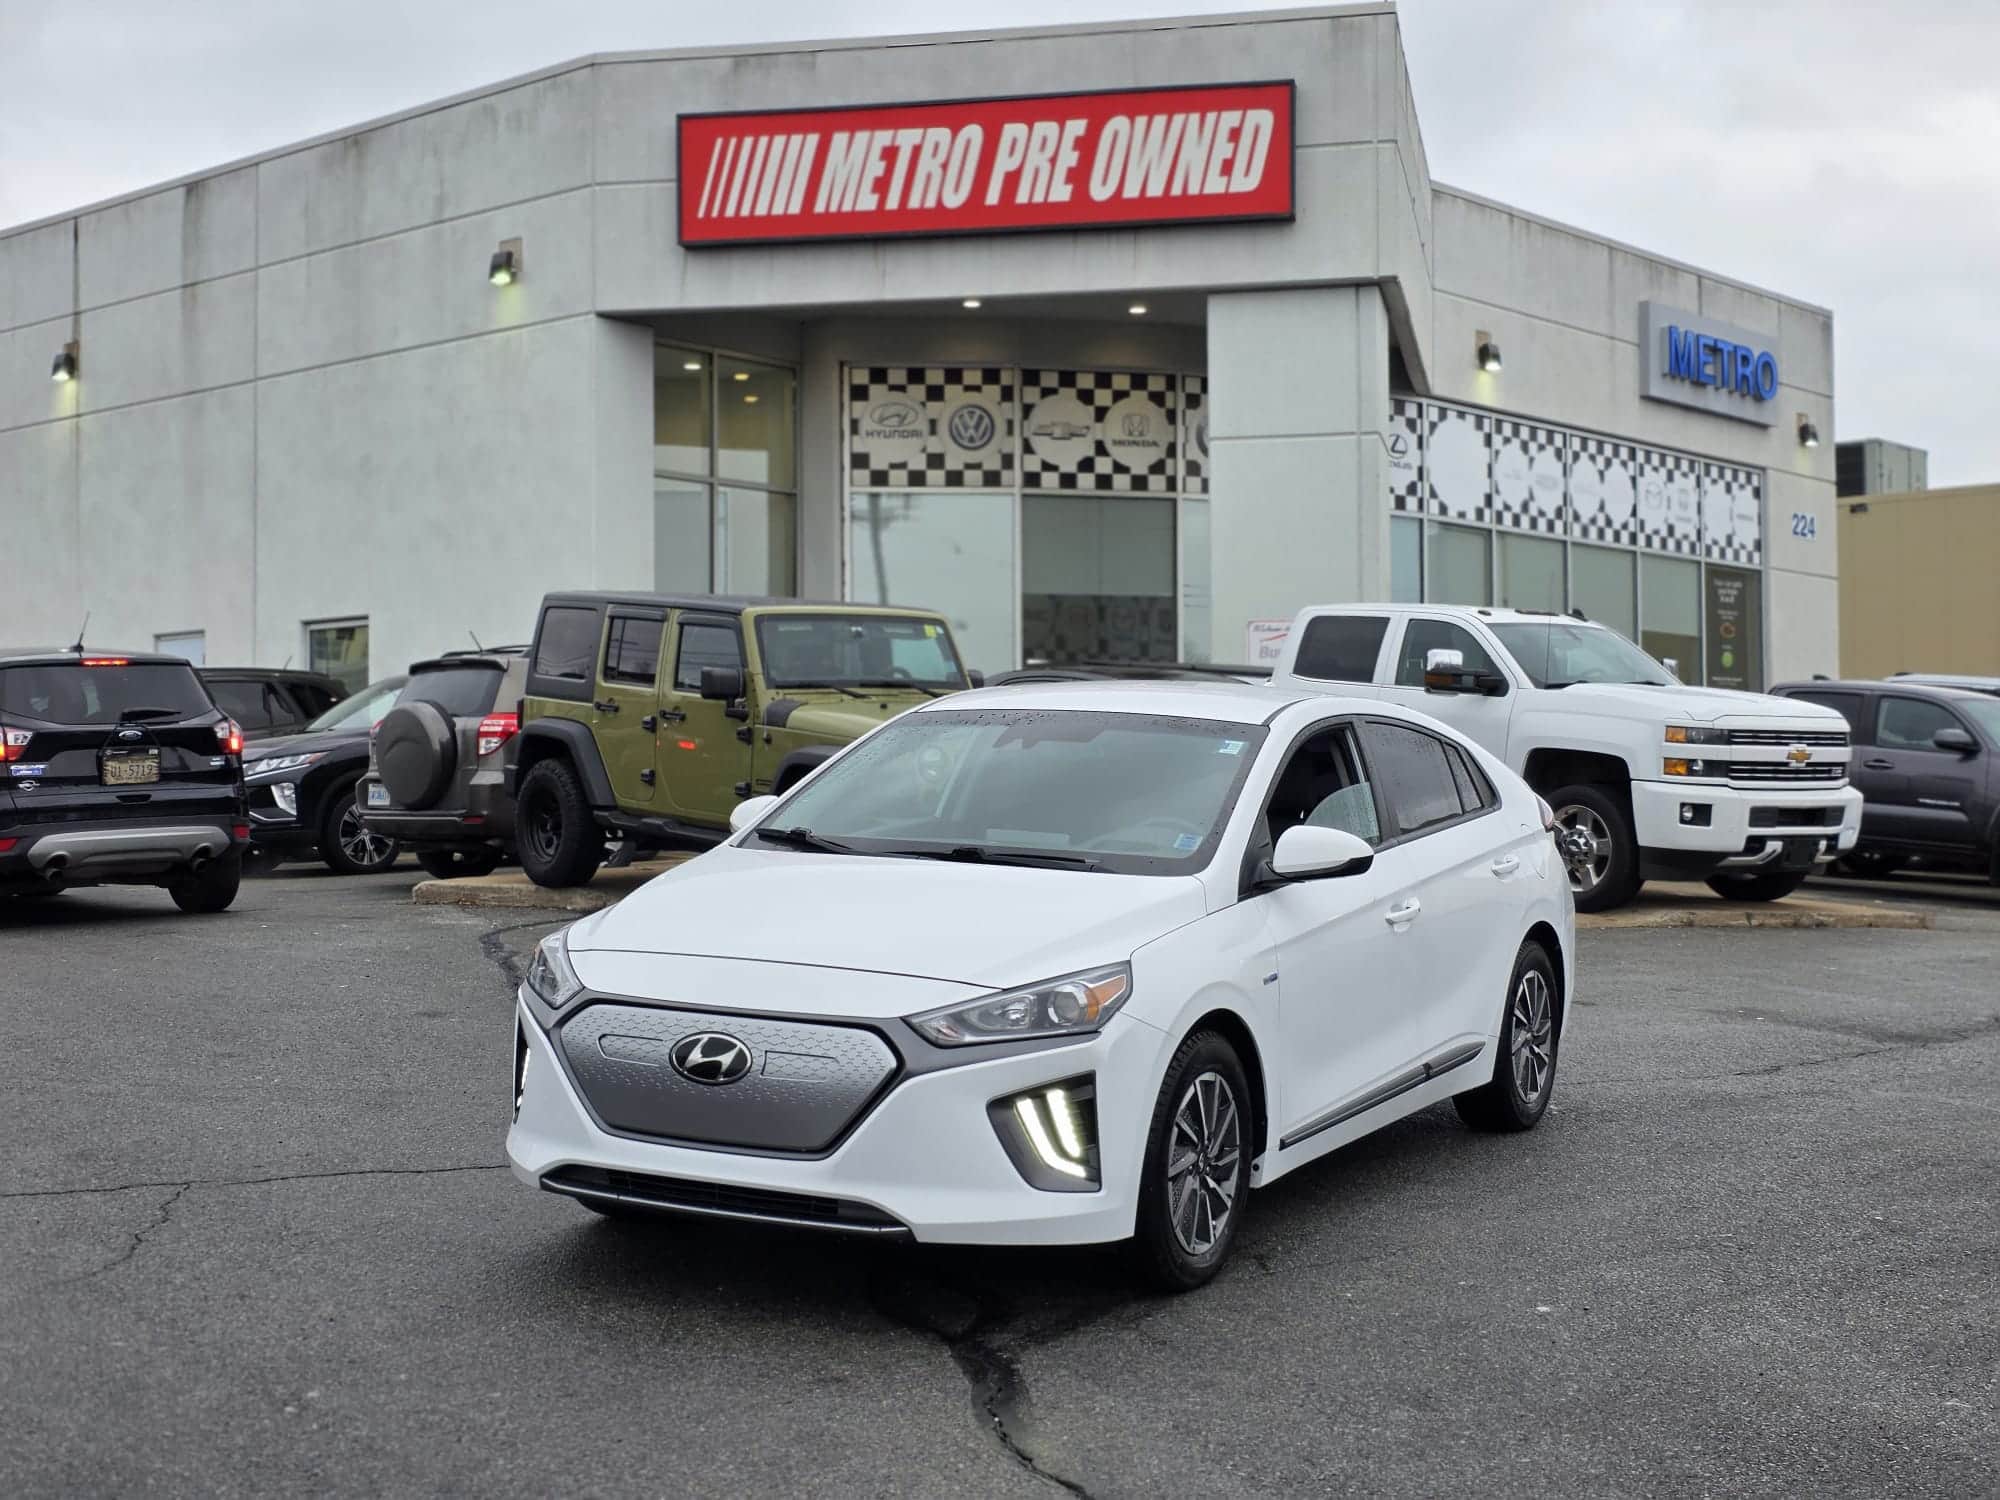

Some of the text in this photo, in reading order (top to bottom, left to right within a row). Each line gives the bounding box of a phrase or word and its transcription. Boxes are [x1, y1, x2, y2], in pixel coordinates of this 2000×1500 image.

[813, 109, 1275, 214] METRO PRE OWNED
[1668, 325, 1778, 401] METRO
[865, 429, 923, 439] HYUNDAI
[1792, 512, 1816, 539] 224
